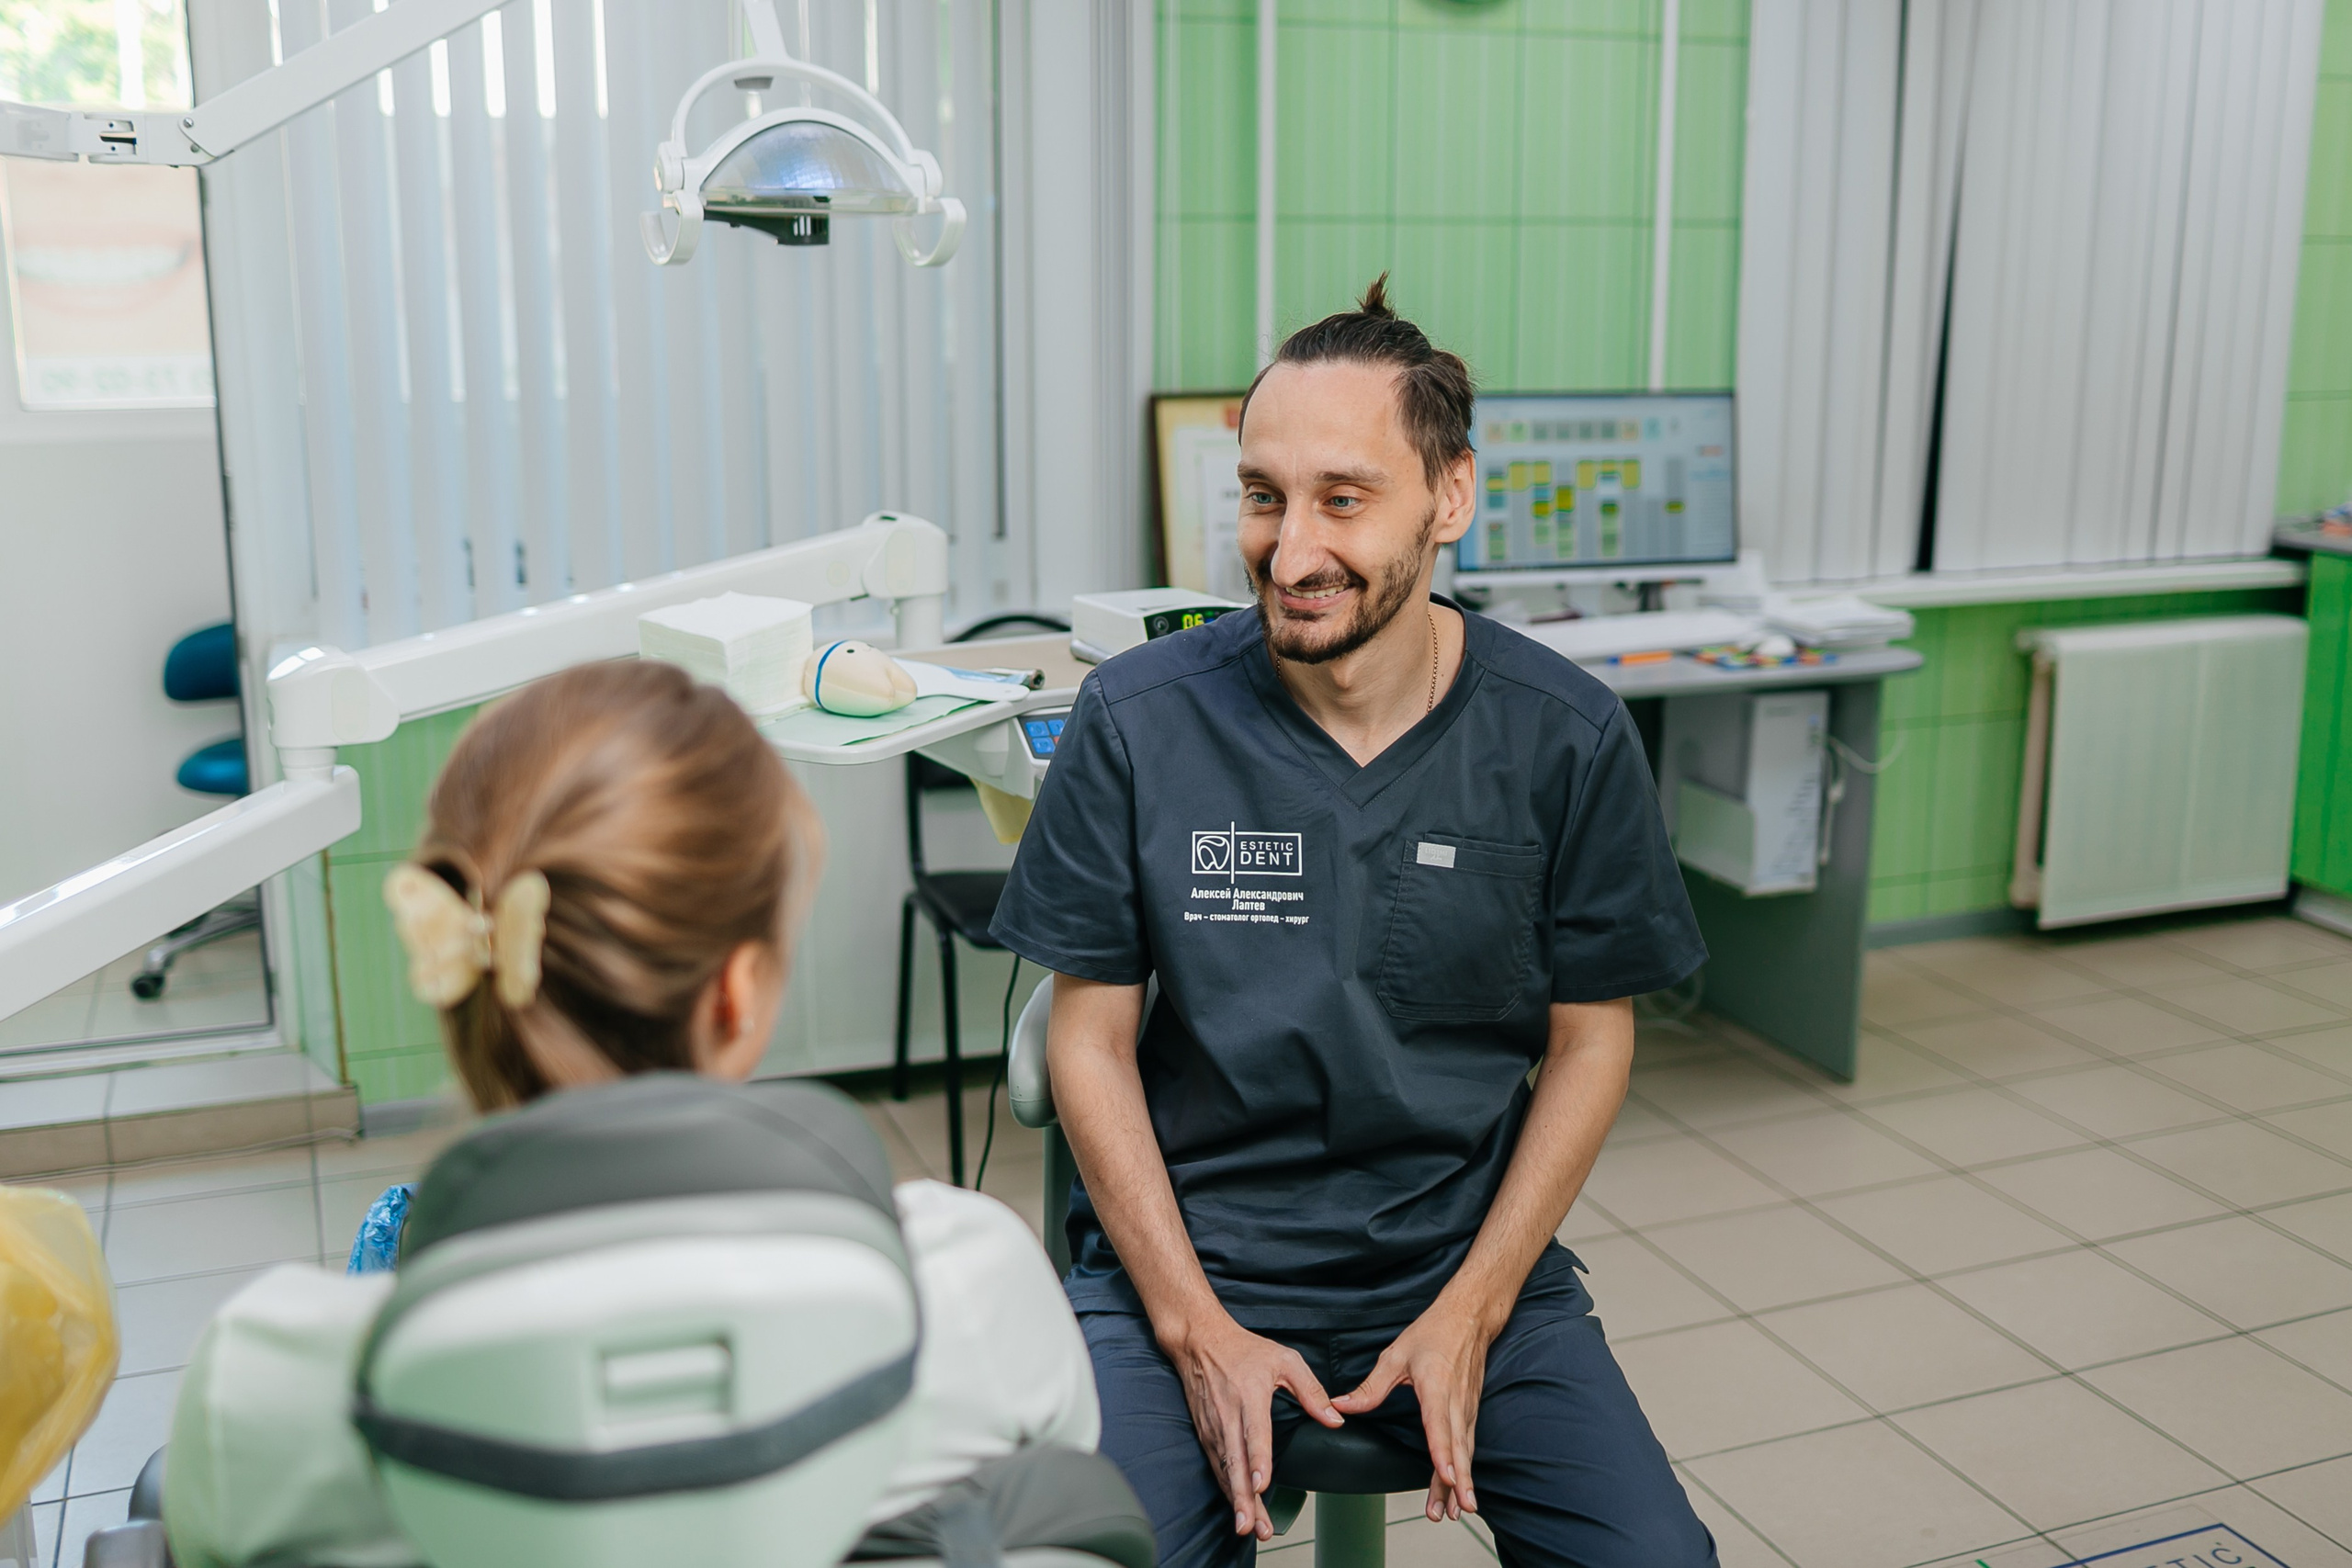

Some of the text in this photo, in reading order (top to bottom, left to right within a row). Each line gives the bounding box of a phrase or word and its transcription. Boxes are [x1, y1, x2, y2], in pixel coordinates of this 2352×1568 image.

[1240, 840, 1294, 851] ESTETIC
[1240, 851, 1294, 865] DENT
[1191, 887, 1304, 902] Алексей Александрович
[1231, 899, 1265, 910] Лаптев
[1184, 911, 1203, 922] Врач
[1209, 913, 1250, 921] стоматолог
[1250, 914, 1280, 924] ортопед
[1285, 916, 1309, 925] хирург
